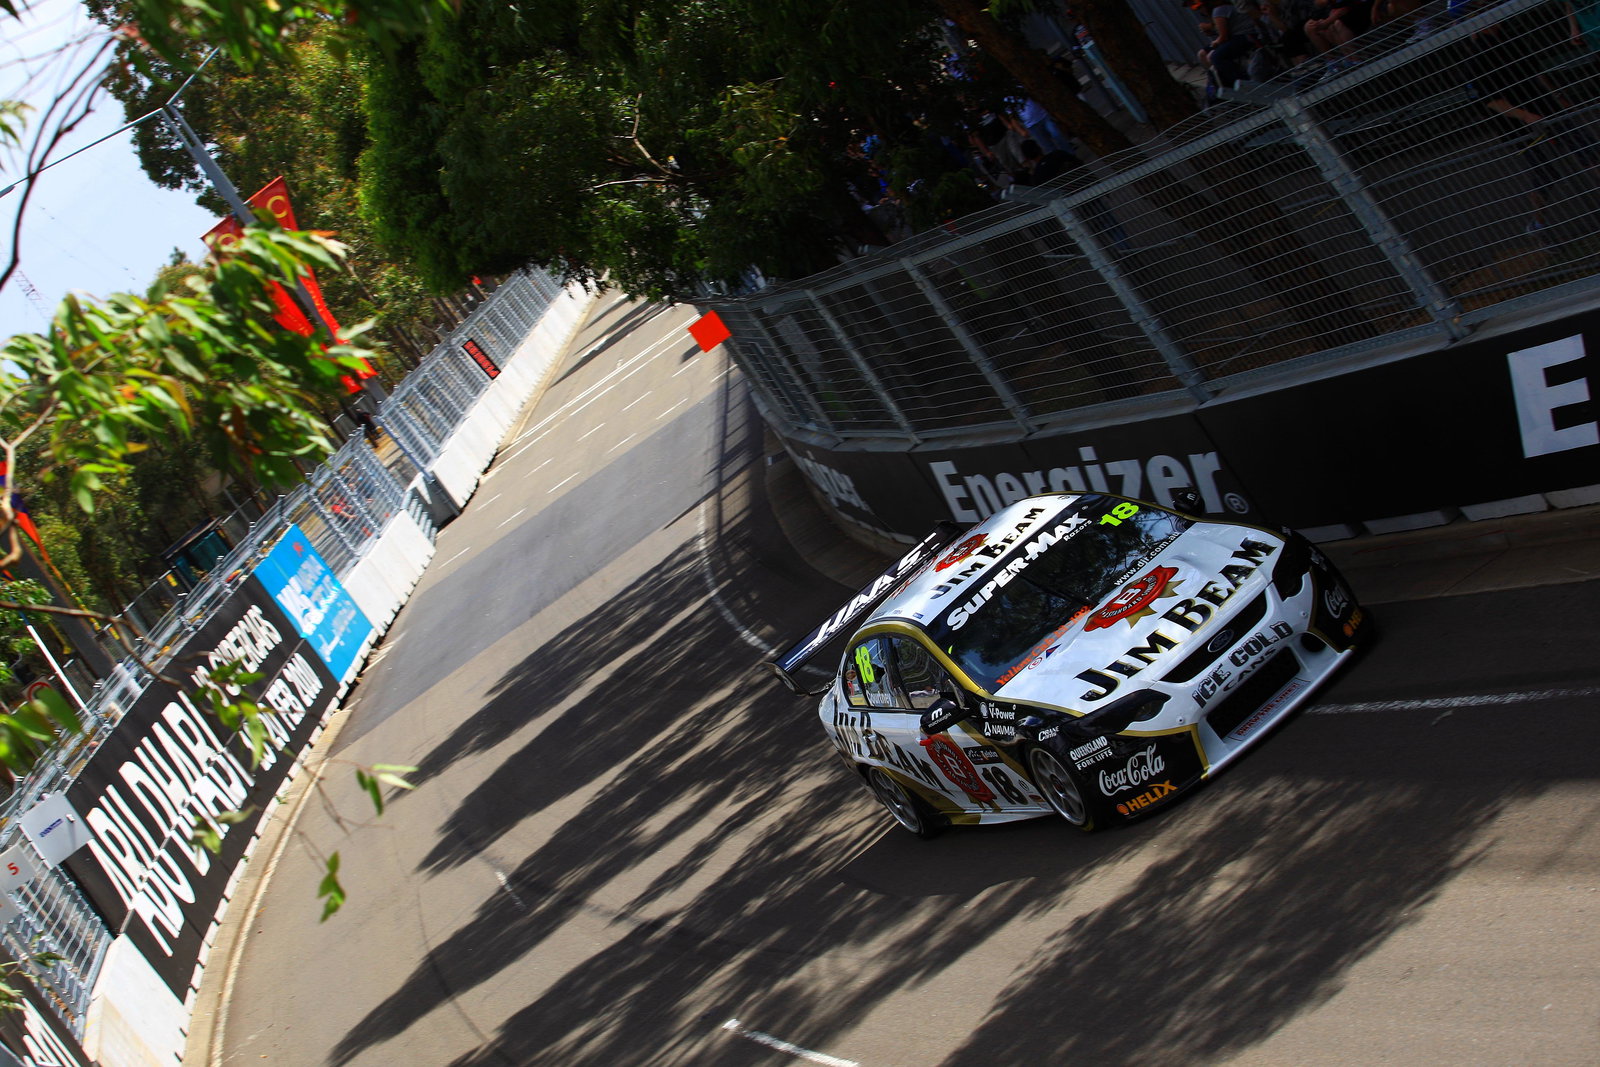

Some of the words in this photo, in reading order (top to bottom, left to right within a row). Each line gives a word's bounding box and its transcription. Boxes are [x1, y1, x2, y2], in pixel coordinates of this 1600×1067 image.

[1063, 519, 1092, 542] Razors
[1100, 502, 1140, 527] 18
[930, 562, 987, 601] JIM
[979, 507, 1047, 559] BEAM
[947, 512, 1088, 631] SUPER-MAX
[1113, 531, 1183, 586] www.djr.com.au
[798, 532, 937, 655] HAAS
[1073, 630, 1180, 701] JIM
[1159, 537, 1278, 635] BEAM
[855, 645, 875, 683] 18
[995, 658, 1032, 686] Yellow
[1192, 664, 1232, 708] ICE
[1228, 621, 1293, 667] COLD
[1222, 647, 1277, 692] CANS
[265, 678, 306, 731] FEB
[989, 708, 1015, 720] V-Power
[1070, 735, 1108, 760] QUEENSLAND
[1077, 758, 1096, 770] FORK
[1095, 749, 1113, 762] LIFTS
[1099, 743, 1165, 796] Coca-Cola
[119, 690, 255, 876] DHABI
[982, 767, 1027, 805] 18
[1128, 780, 1178, 812] HELIX
[87, 784, 195, 957] ABU
